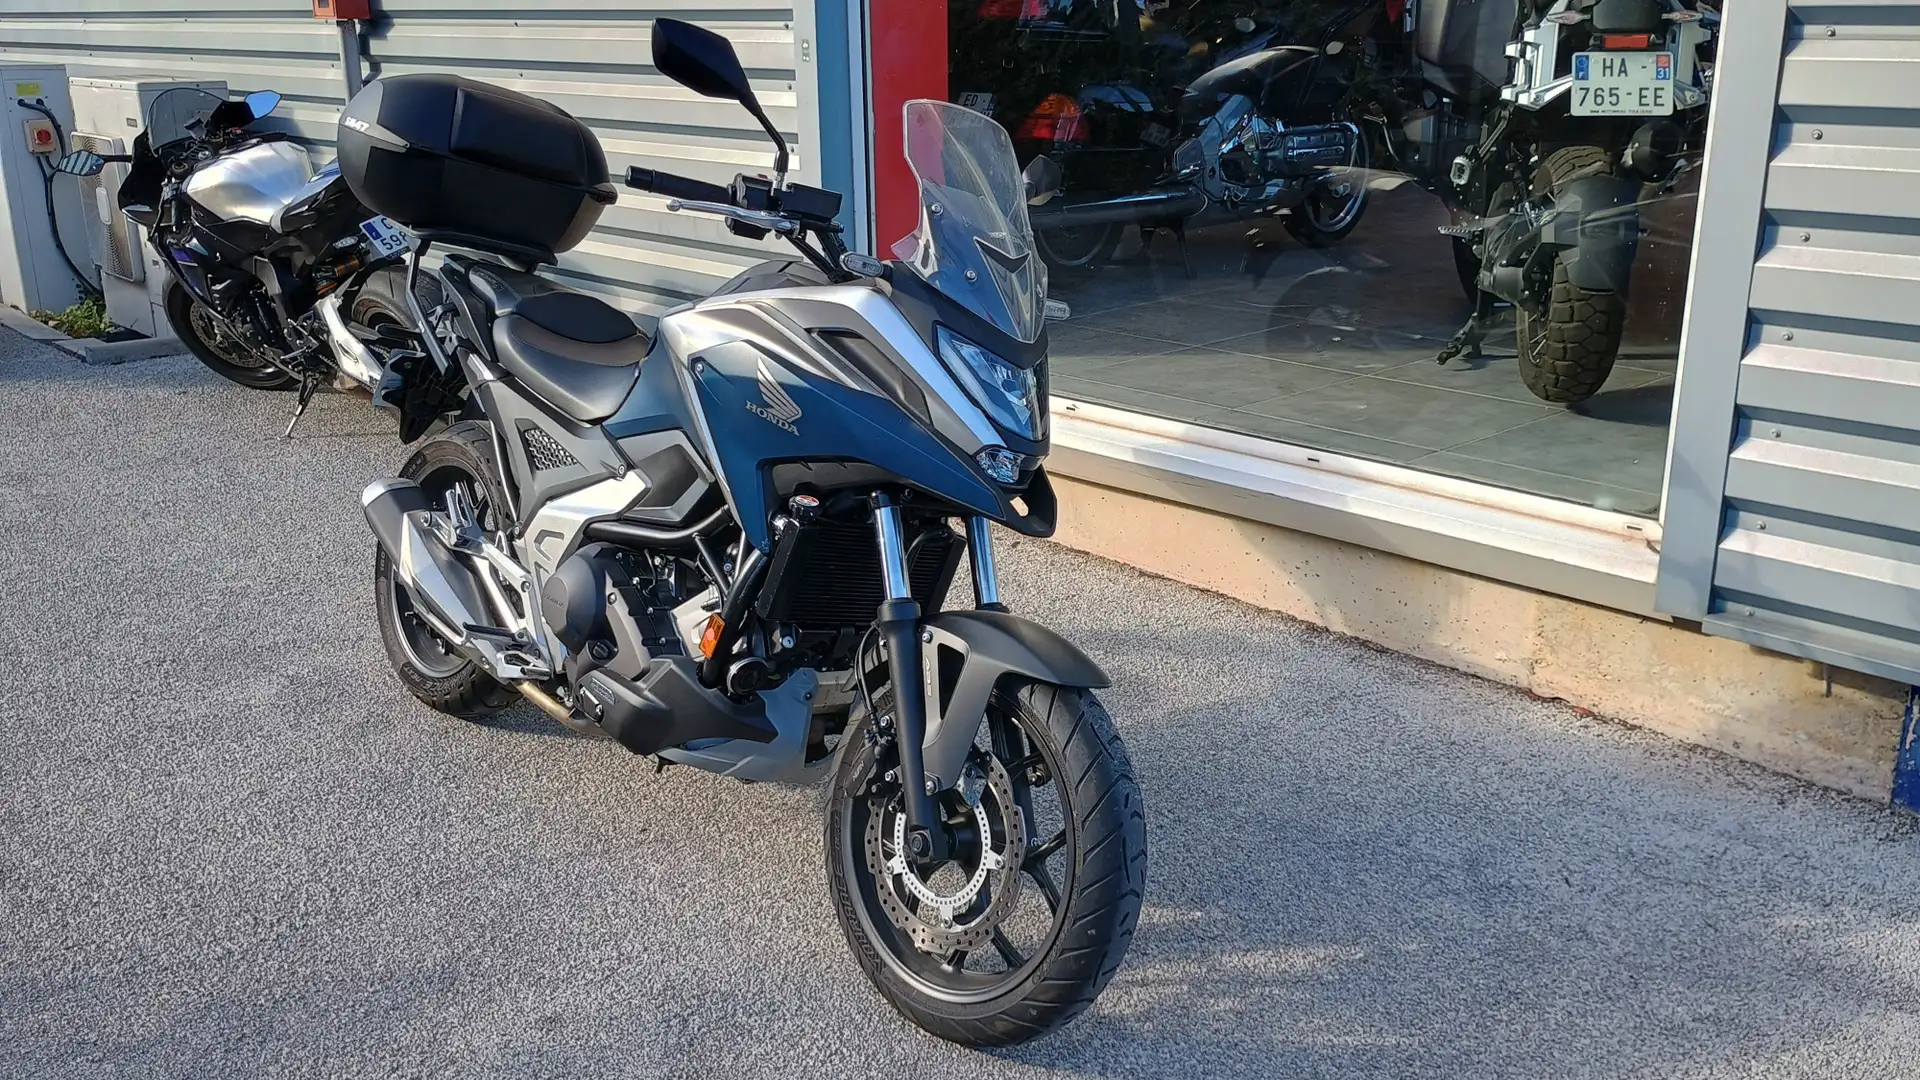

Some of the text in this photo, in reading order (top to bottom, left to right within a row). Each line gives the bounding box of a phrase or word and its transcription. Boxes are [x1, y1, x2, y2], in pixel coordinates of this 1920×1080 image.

[1602, 57, 1628, 78] HA
[1657, 67, 1670, 79] 31
[745, 399, 800, 436] HONDA
